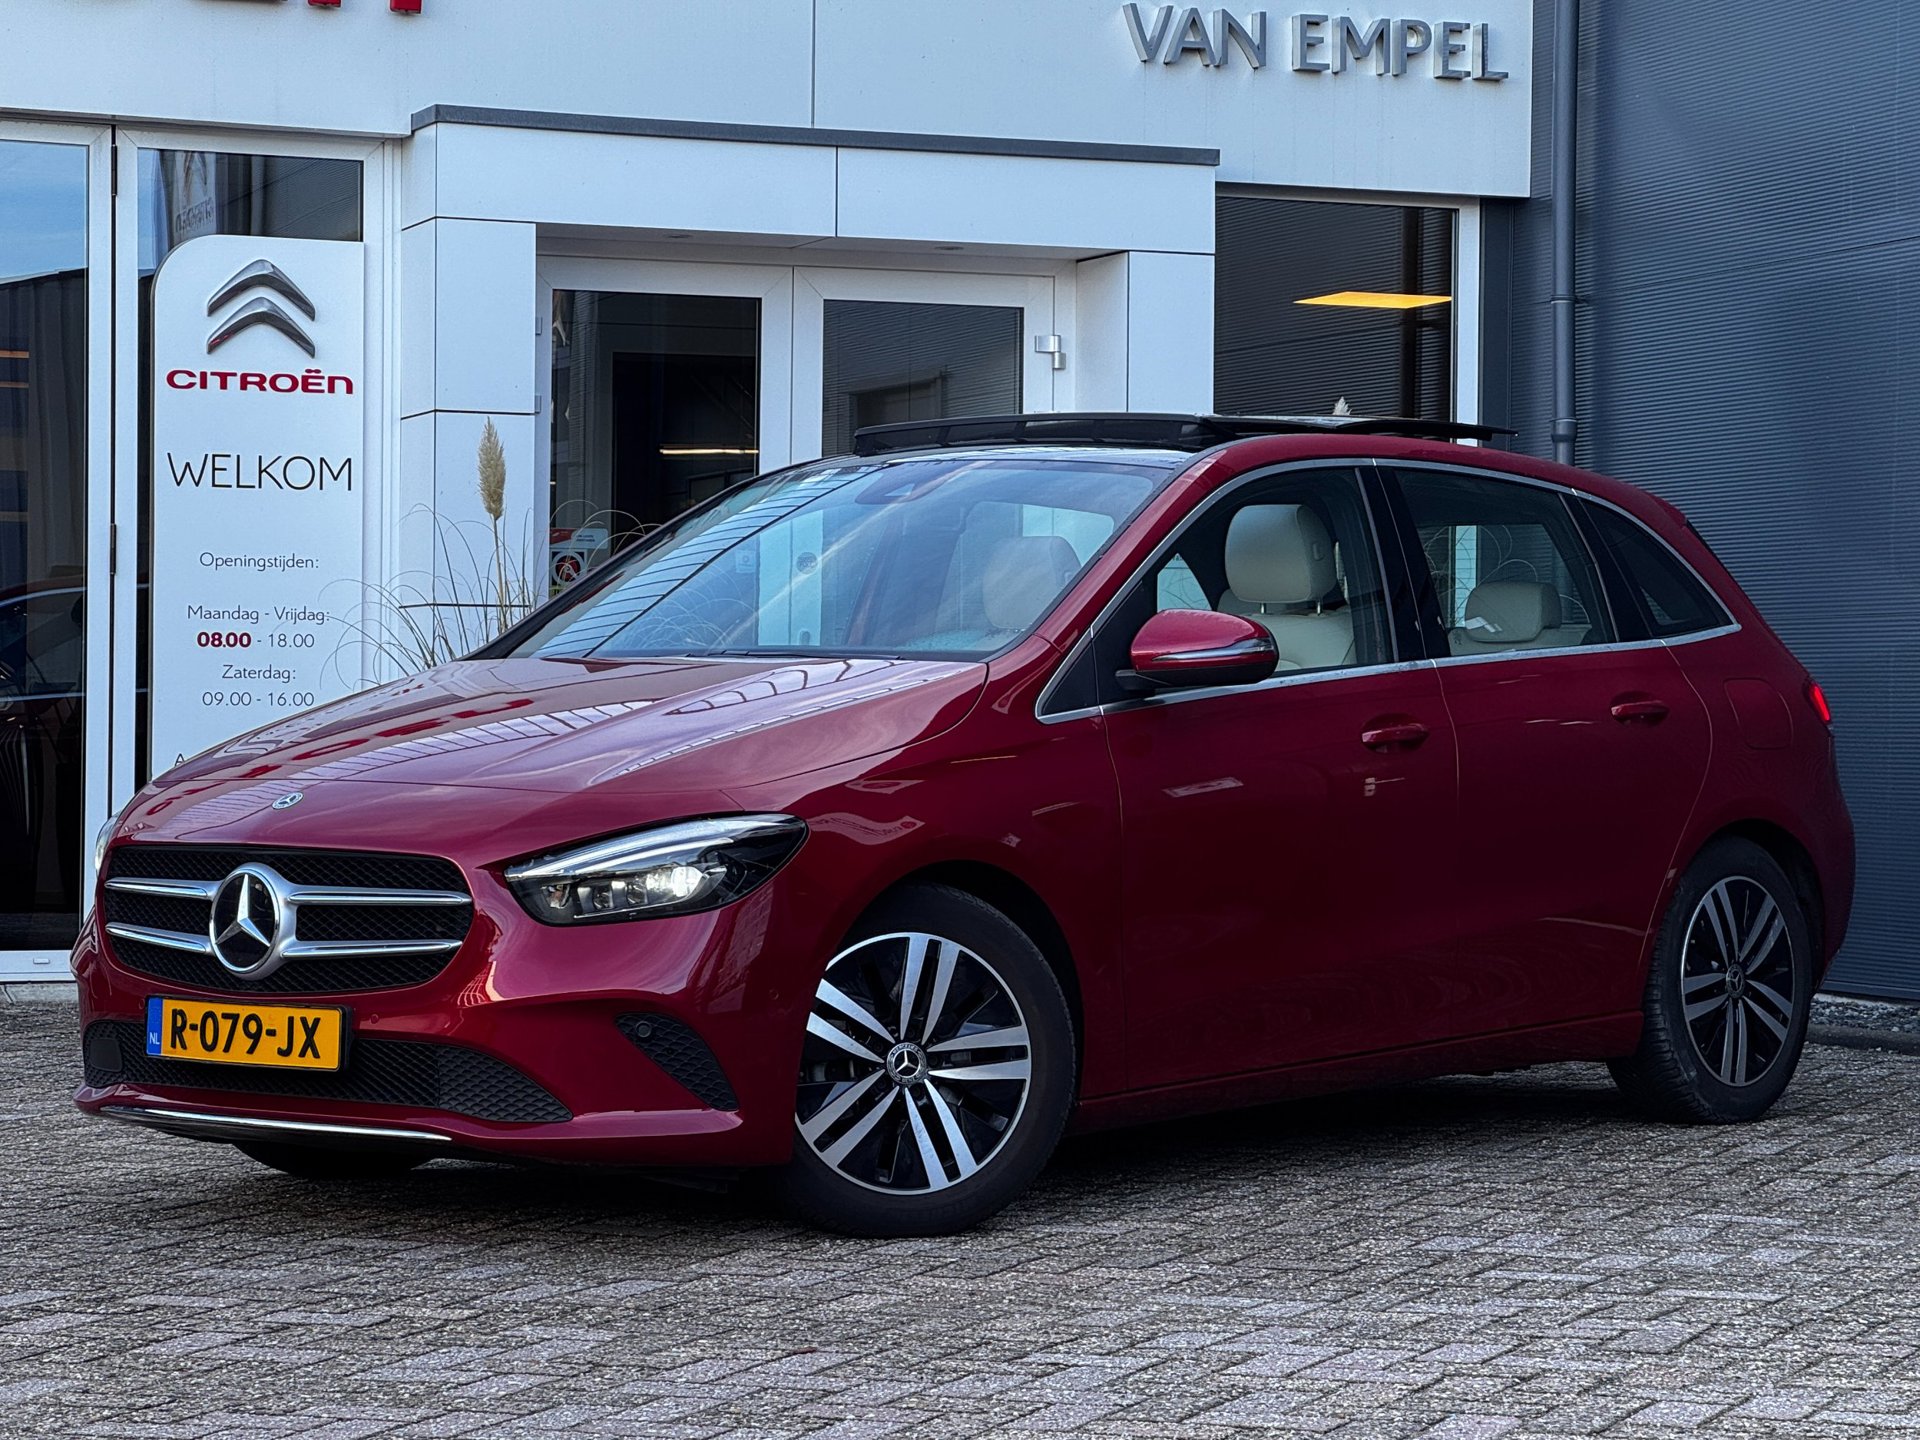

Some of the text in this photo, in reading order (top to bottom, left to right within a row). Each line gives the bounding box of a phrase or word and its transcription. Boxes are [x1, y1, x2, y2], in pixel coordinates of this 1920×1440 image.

[1122, 2, 1509, 81] VAN EMPEL
[167, 453, 352, 492] WELKOM
[199, 552, 319, 572] Openingstijden:
[187, 605, 259, 625] Maandag
[273, 606, 330, 626] Vrijdag:
[196, 631, 252, 648] 08.00
[268, 633, 315, 648] 18.00
[221, 664, 296, 684] Zaterdag:
[202, 691, 252, 707] 09.00
[268, 692, 315, 707] 16.00
[149, 1031, 160, 1045] NL
[170, 1008, 321, 1059] R-079-JX
